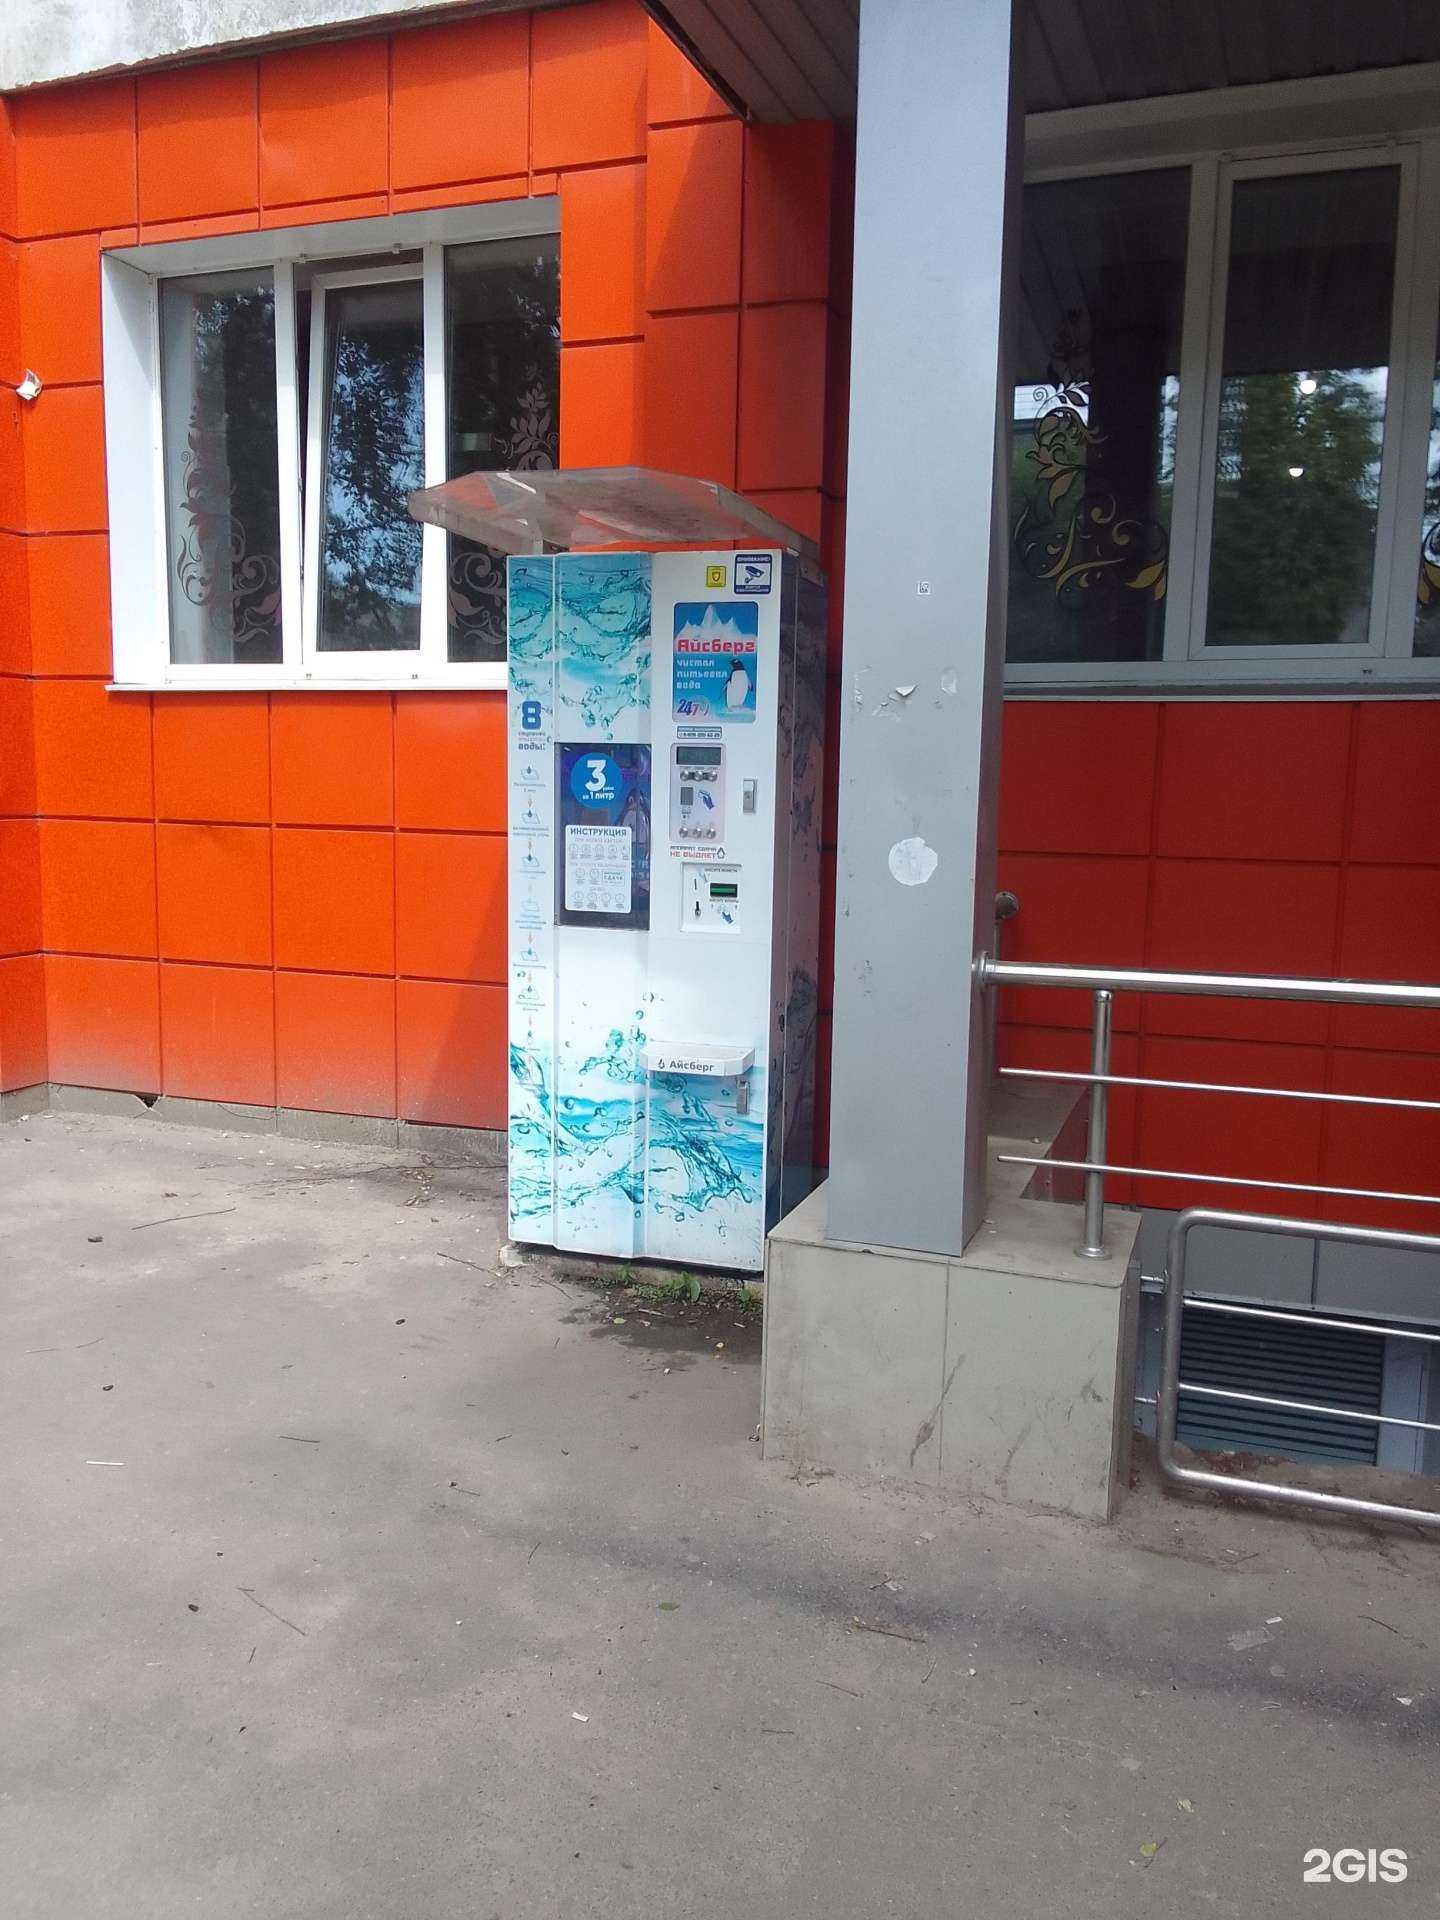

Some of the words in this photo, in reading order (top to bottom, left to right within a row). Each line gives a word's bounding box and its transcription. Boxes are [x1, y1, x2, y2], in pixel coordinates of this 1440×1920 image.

[677, 639, 756, 655] Айсберг
[677, 659, 715, 667] чистая
[677, 671, 728, 679] питьевая
[677, 681, 701, 689] вода
[521, 701, 542, 730] 8
[585, 759, 608, 791] 3
[595, 793, 615, 802] литр
[570, 828, 627, 837] ИНСТРУКЦИЯ
[669, 1060, 715, 1073] Айсберг
